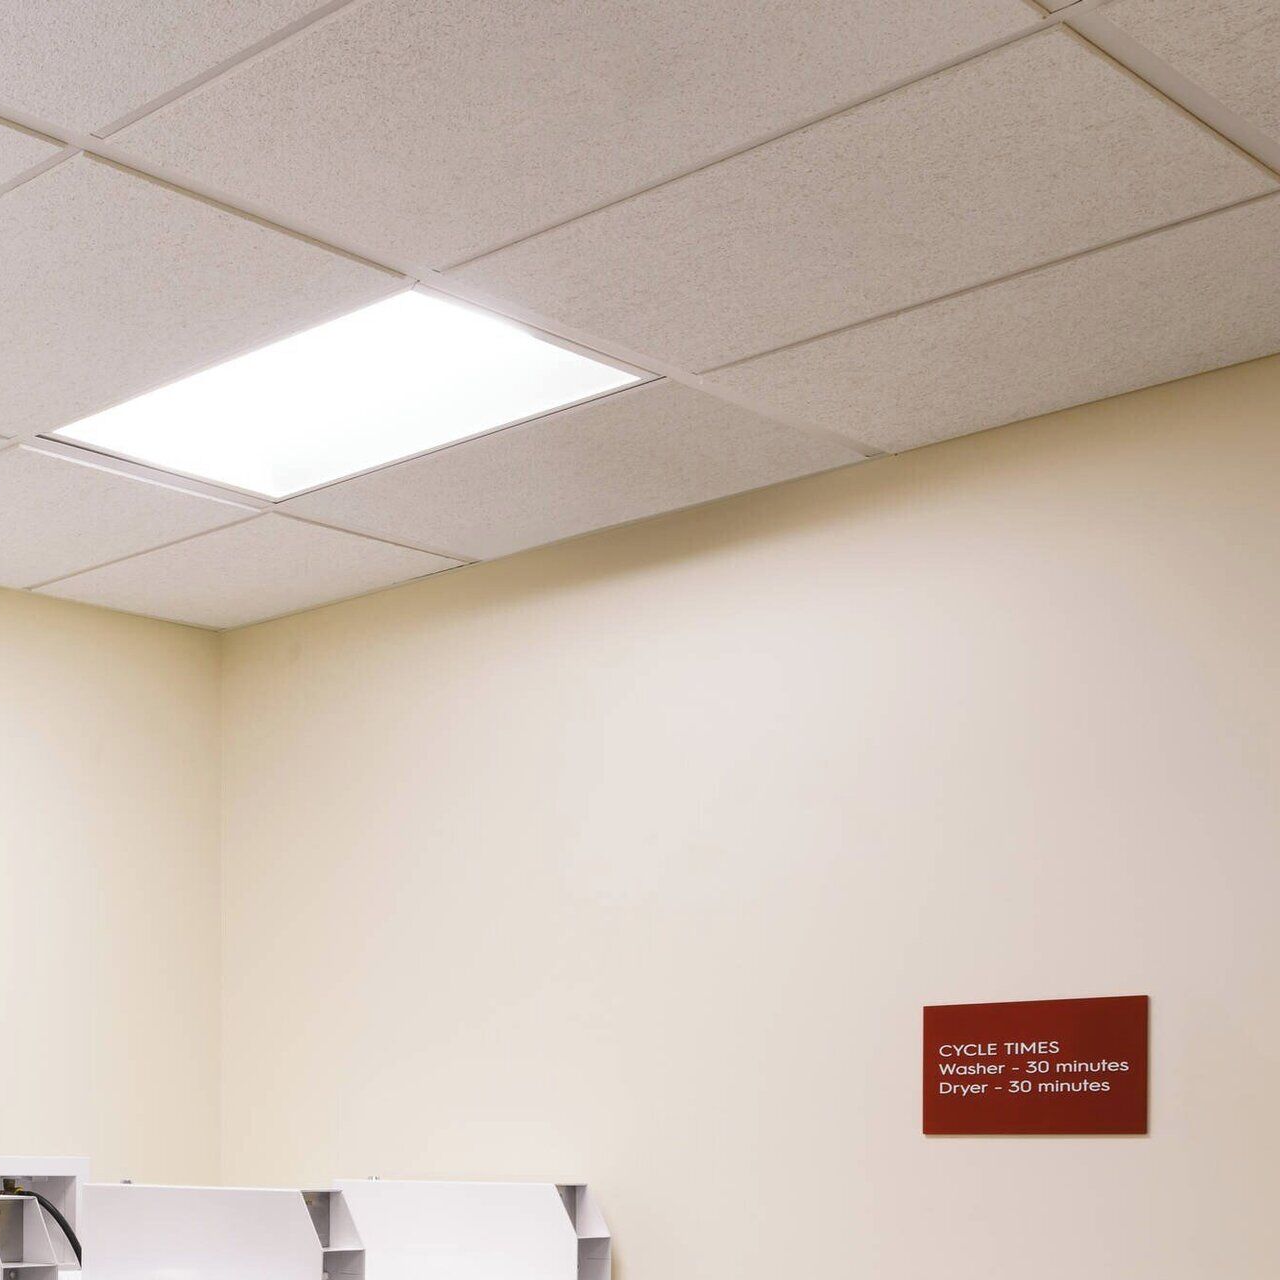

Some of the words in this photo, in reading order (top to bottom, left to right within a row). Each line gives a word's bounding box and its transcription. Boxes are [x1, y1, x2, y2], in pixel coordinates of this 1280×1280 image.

[939, 1043, 998, 1058] CYCLE
[1004, 1041, 1060, 1055] TIMES
[939, 1062, 1006, 1076] Washer
[1025, 1060, 1050, 1074] 30
[1055, 1059, 1130, 1073] minutes
[939, 1082, 989, 1097] Dryer
[1008, 1080, 1032, 1093] 30
[1037, 1079, 1111, 1093] minutes
